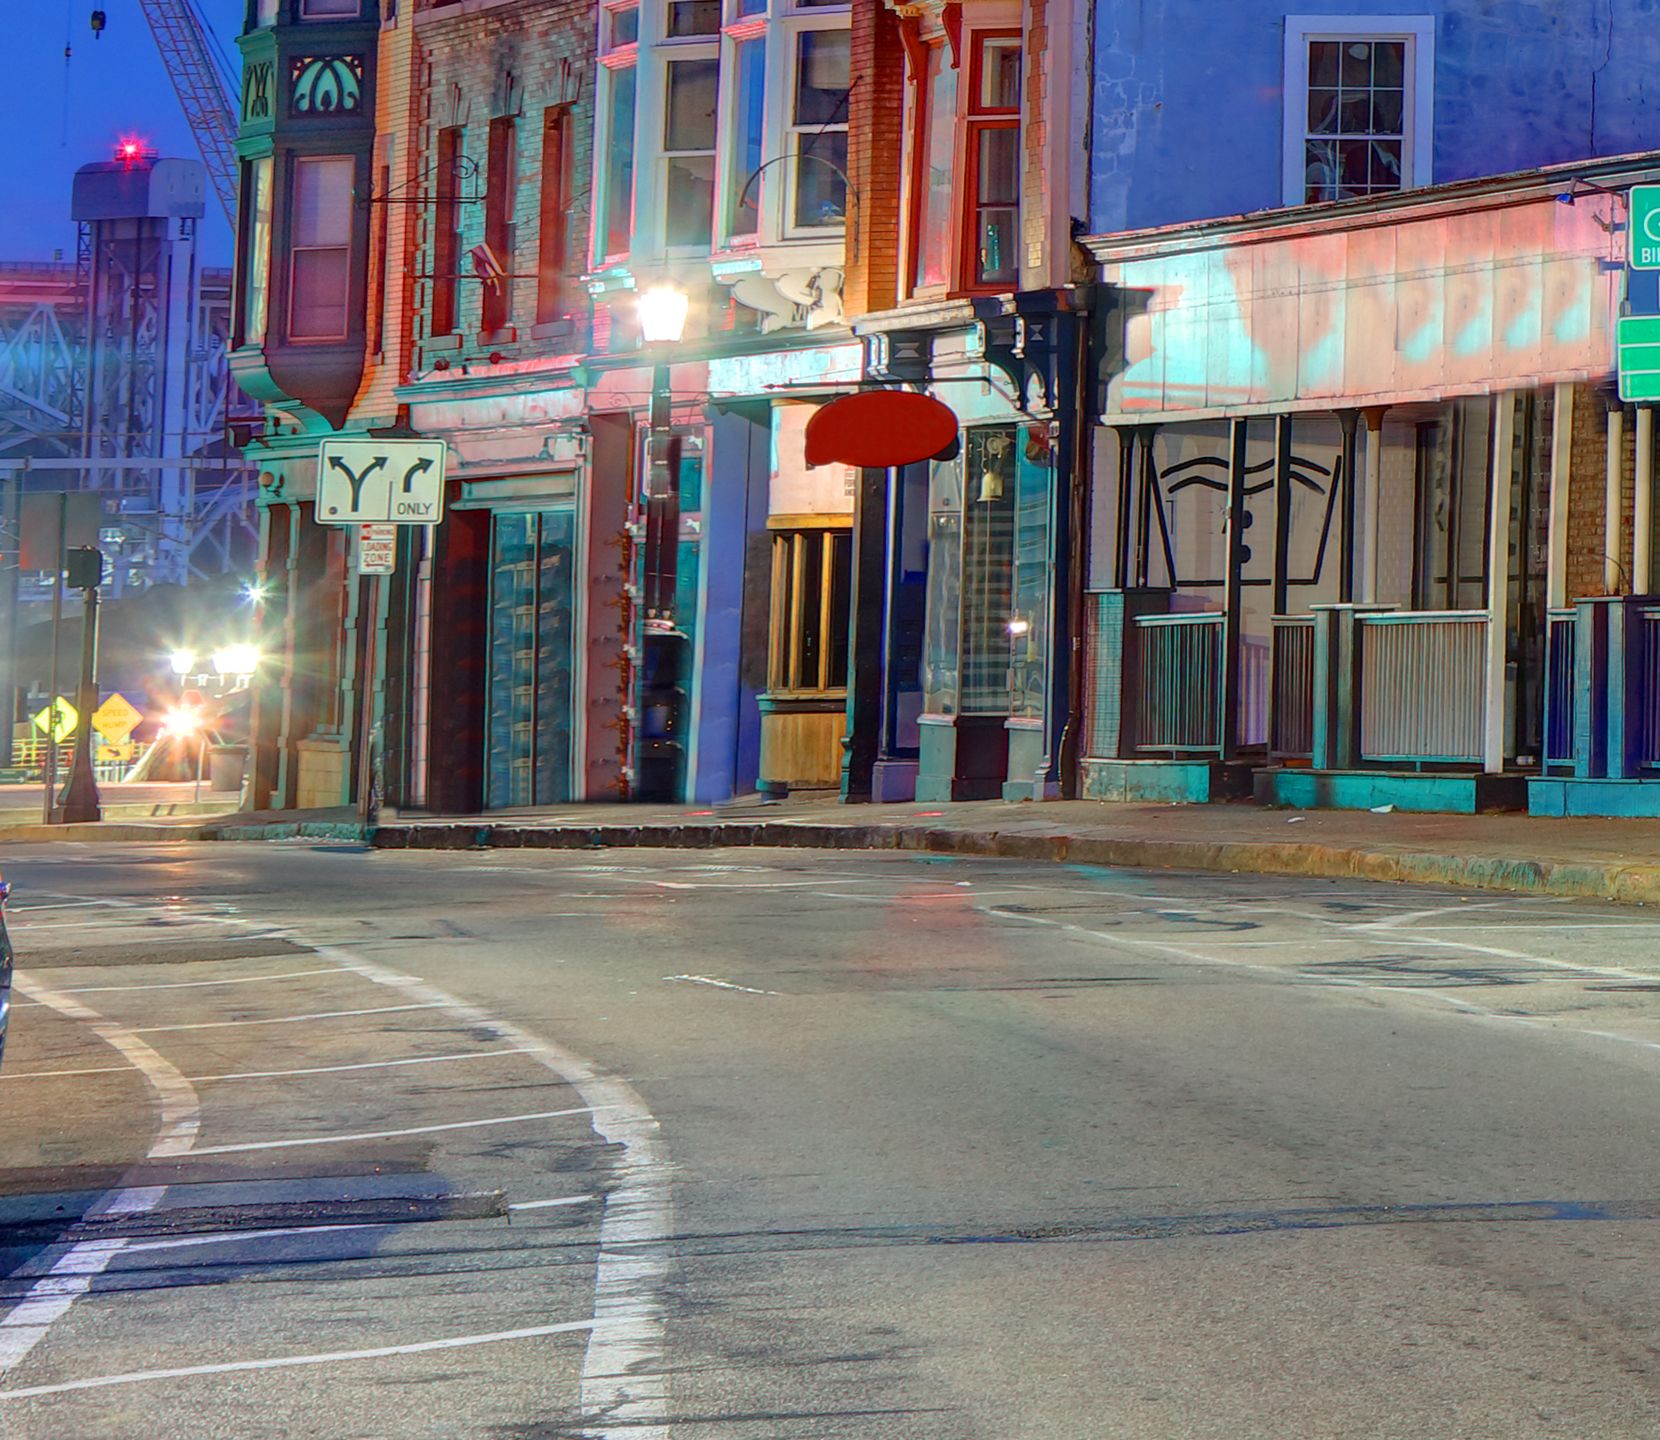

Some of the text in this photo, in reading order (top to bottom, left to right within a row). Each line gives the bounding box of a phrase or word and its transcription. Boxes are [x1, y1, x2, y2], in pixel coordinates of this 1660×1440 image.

[397, 502, 433, 516] ONLY
[363, 552, 390, 563] ZONE
[102, 709, 129, 717] SPEED
